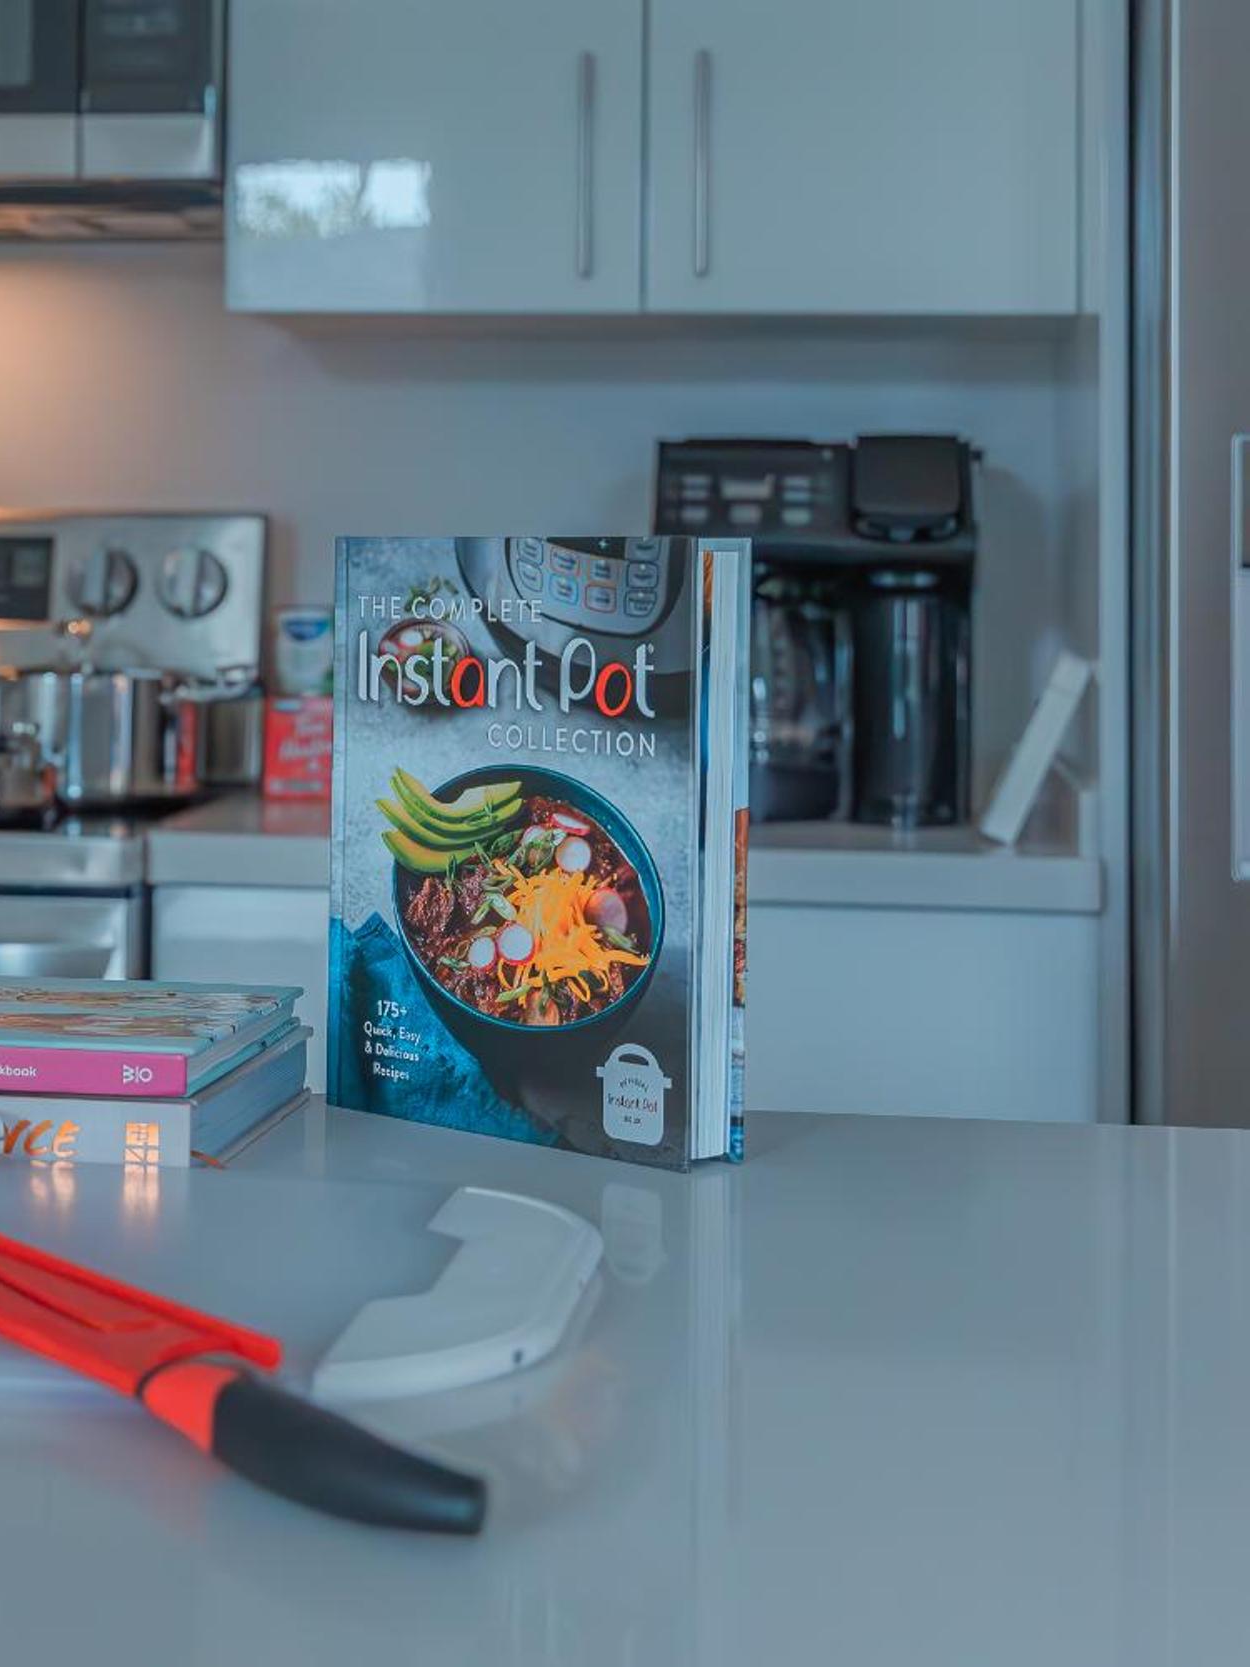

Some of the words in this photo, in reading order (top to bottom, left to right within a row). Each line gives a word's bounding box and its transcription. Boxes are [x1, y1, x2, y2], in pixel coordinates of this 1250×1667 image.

[358, 595, 401, 620] THE
[411, 596, 544, 624] COMPLETE
[358, 630, 544, 712] Instant
[559, 636, 657, 719] Pot
[487, 723, 657, 758] COLLECTION
[377, 999, 408, 1018] 175+
[363, 1021, 396, 1041] Quick,
[399, 1026, 422, 1047] Easy
[364, 1040, 373, 1054] &
[375, 1042, 420, 1062] Delicious
[372, 1061, 410, 1083] Recipes
